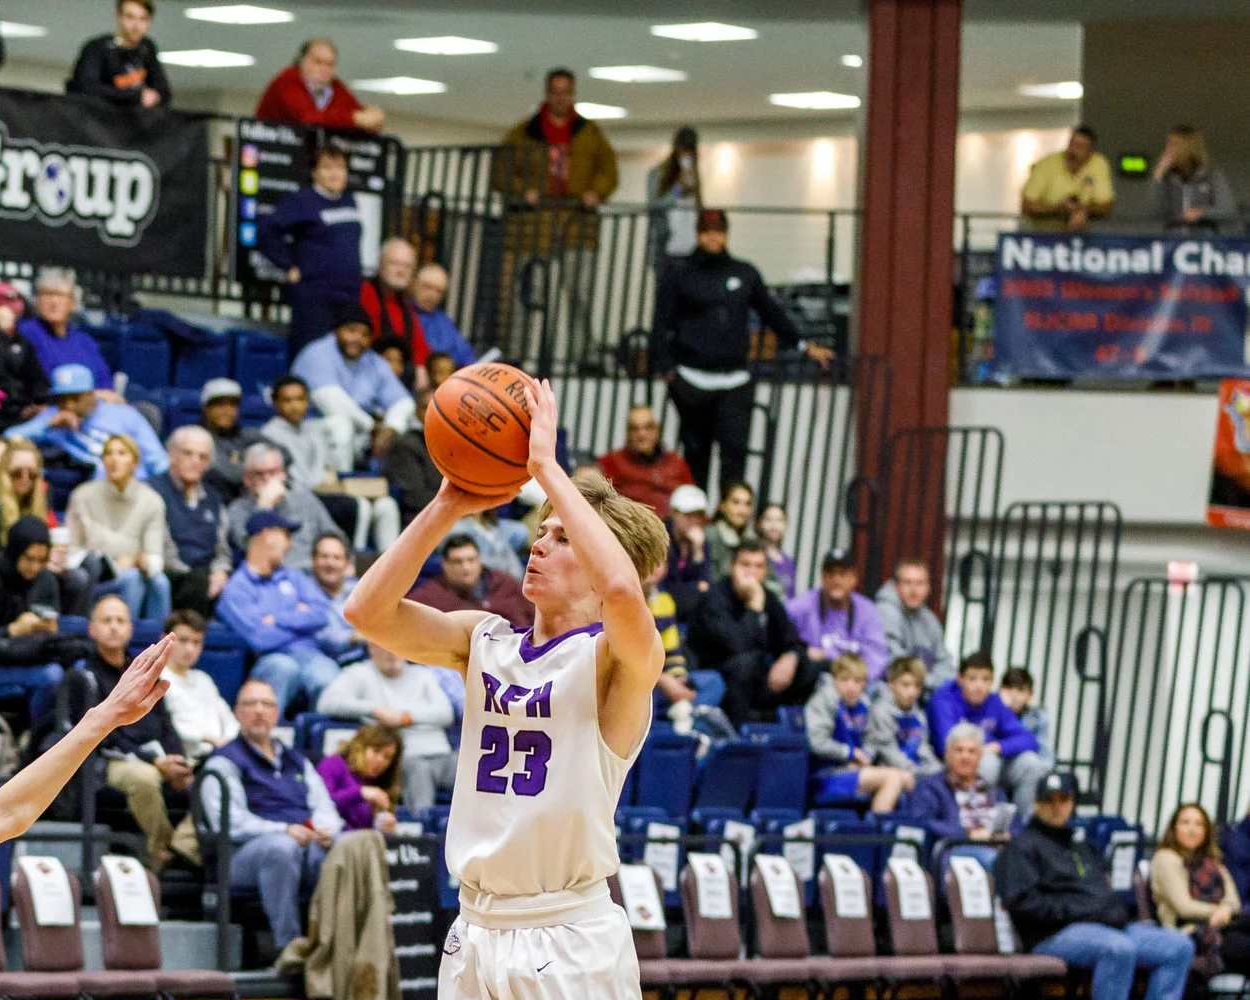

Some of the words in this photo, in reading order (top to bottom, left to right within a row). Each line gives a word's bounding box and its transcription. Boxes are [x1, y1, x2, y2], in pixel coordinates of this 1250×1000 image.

[1002, 236, 1165, 274] National
[1172, 240, 1250, 278] Cha
[481, 671, 553, 719] RFH
[475, 724, 553, 798] 23
